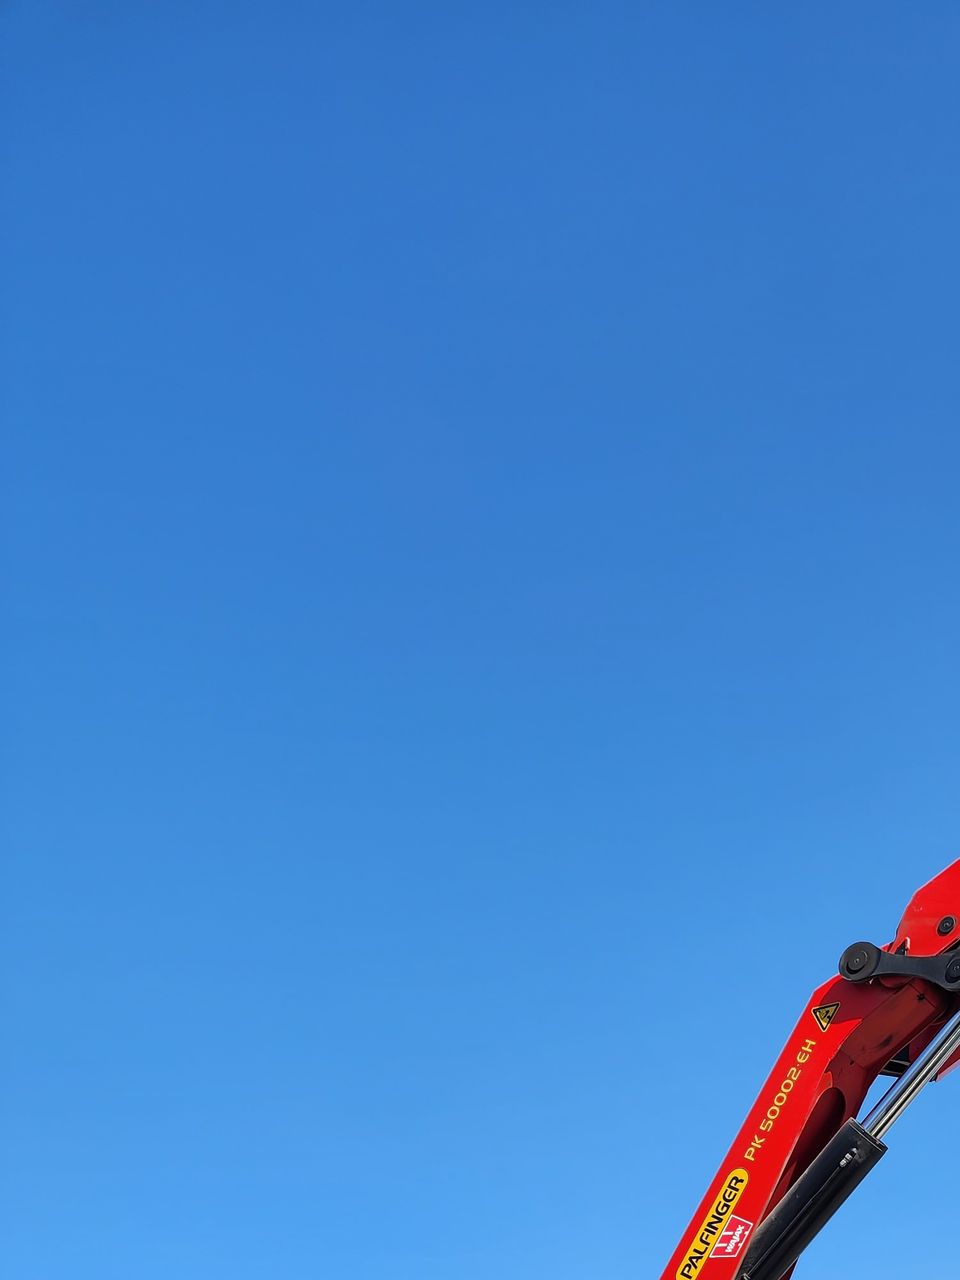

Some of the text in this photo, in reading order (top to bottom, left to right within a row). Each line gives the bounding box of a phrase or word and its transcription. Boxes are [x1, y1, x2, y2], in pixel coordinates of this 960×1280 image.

[744, 1134, 765, 1161] PK
[680, 1176, 744, 1280] PALFINGER
[725, 1225, 744, 1253] WAJAX
